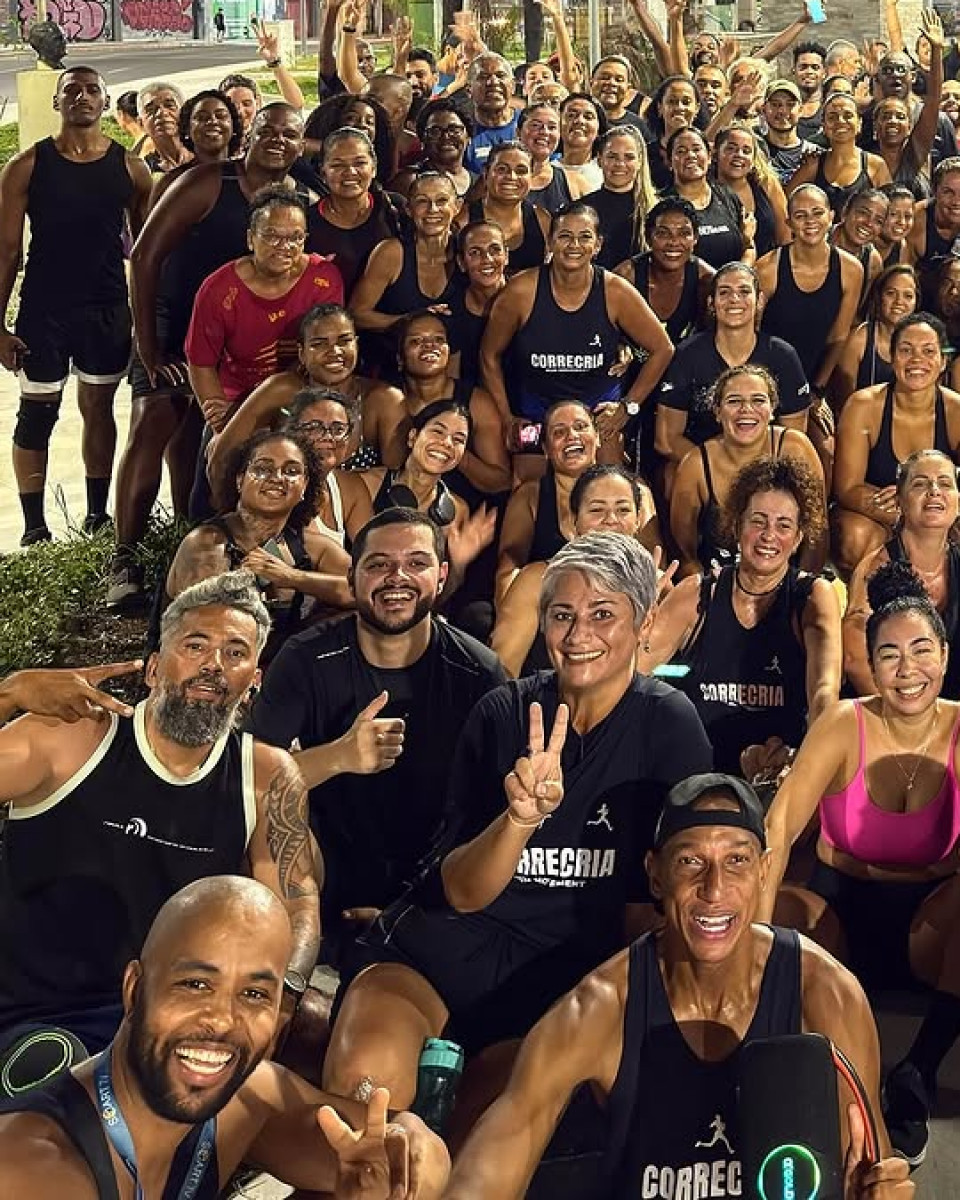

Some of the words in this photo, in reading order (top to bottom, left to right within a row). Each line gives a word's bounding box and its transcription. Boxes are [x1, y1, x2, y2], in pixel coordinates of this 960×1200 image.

[531, 353, 604, 369] CORRECRIA
[700, 682, 785, 707] CORRECRIA
[516, 847, 616, 878] RRECRIA
[641, 1159, 742, 1200] CORREC
